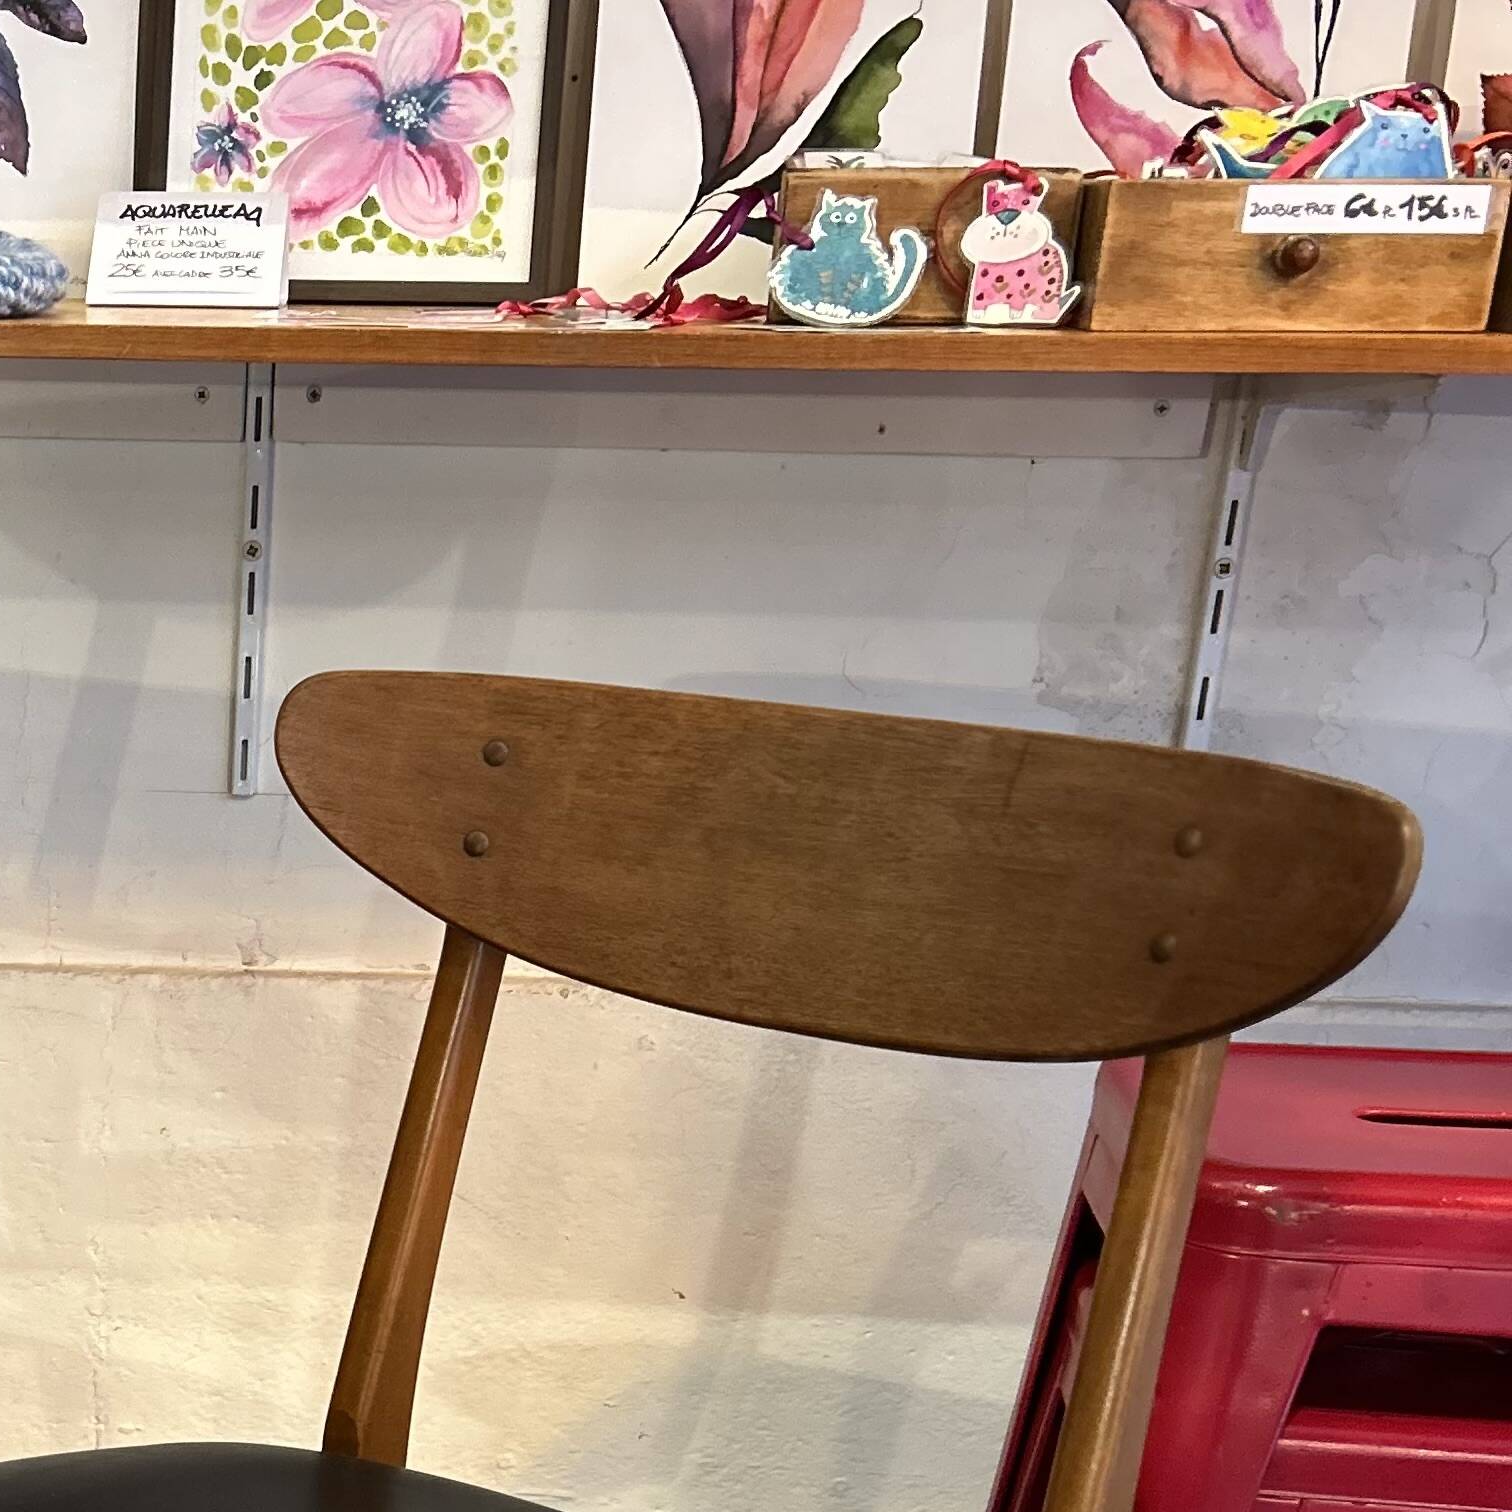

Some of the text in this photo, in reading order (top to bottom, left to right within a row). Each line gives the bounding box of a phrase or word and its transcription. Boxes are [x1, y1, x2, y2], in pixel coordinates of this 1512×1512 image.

[119, 203, 234, 221] AQUARELLE
[136, 224, 217, 237] FAIT MAIN
[107, 263, 146, 278] 25€
[219, 265, 263, 278] 35€
